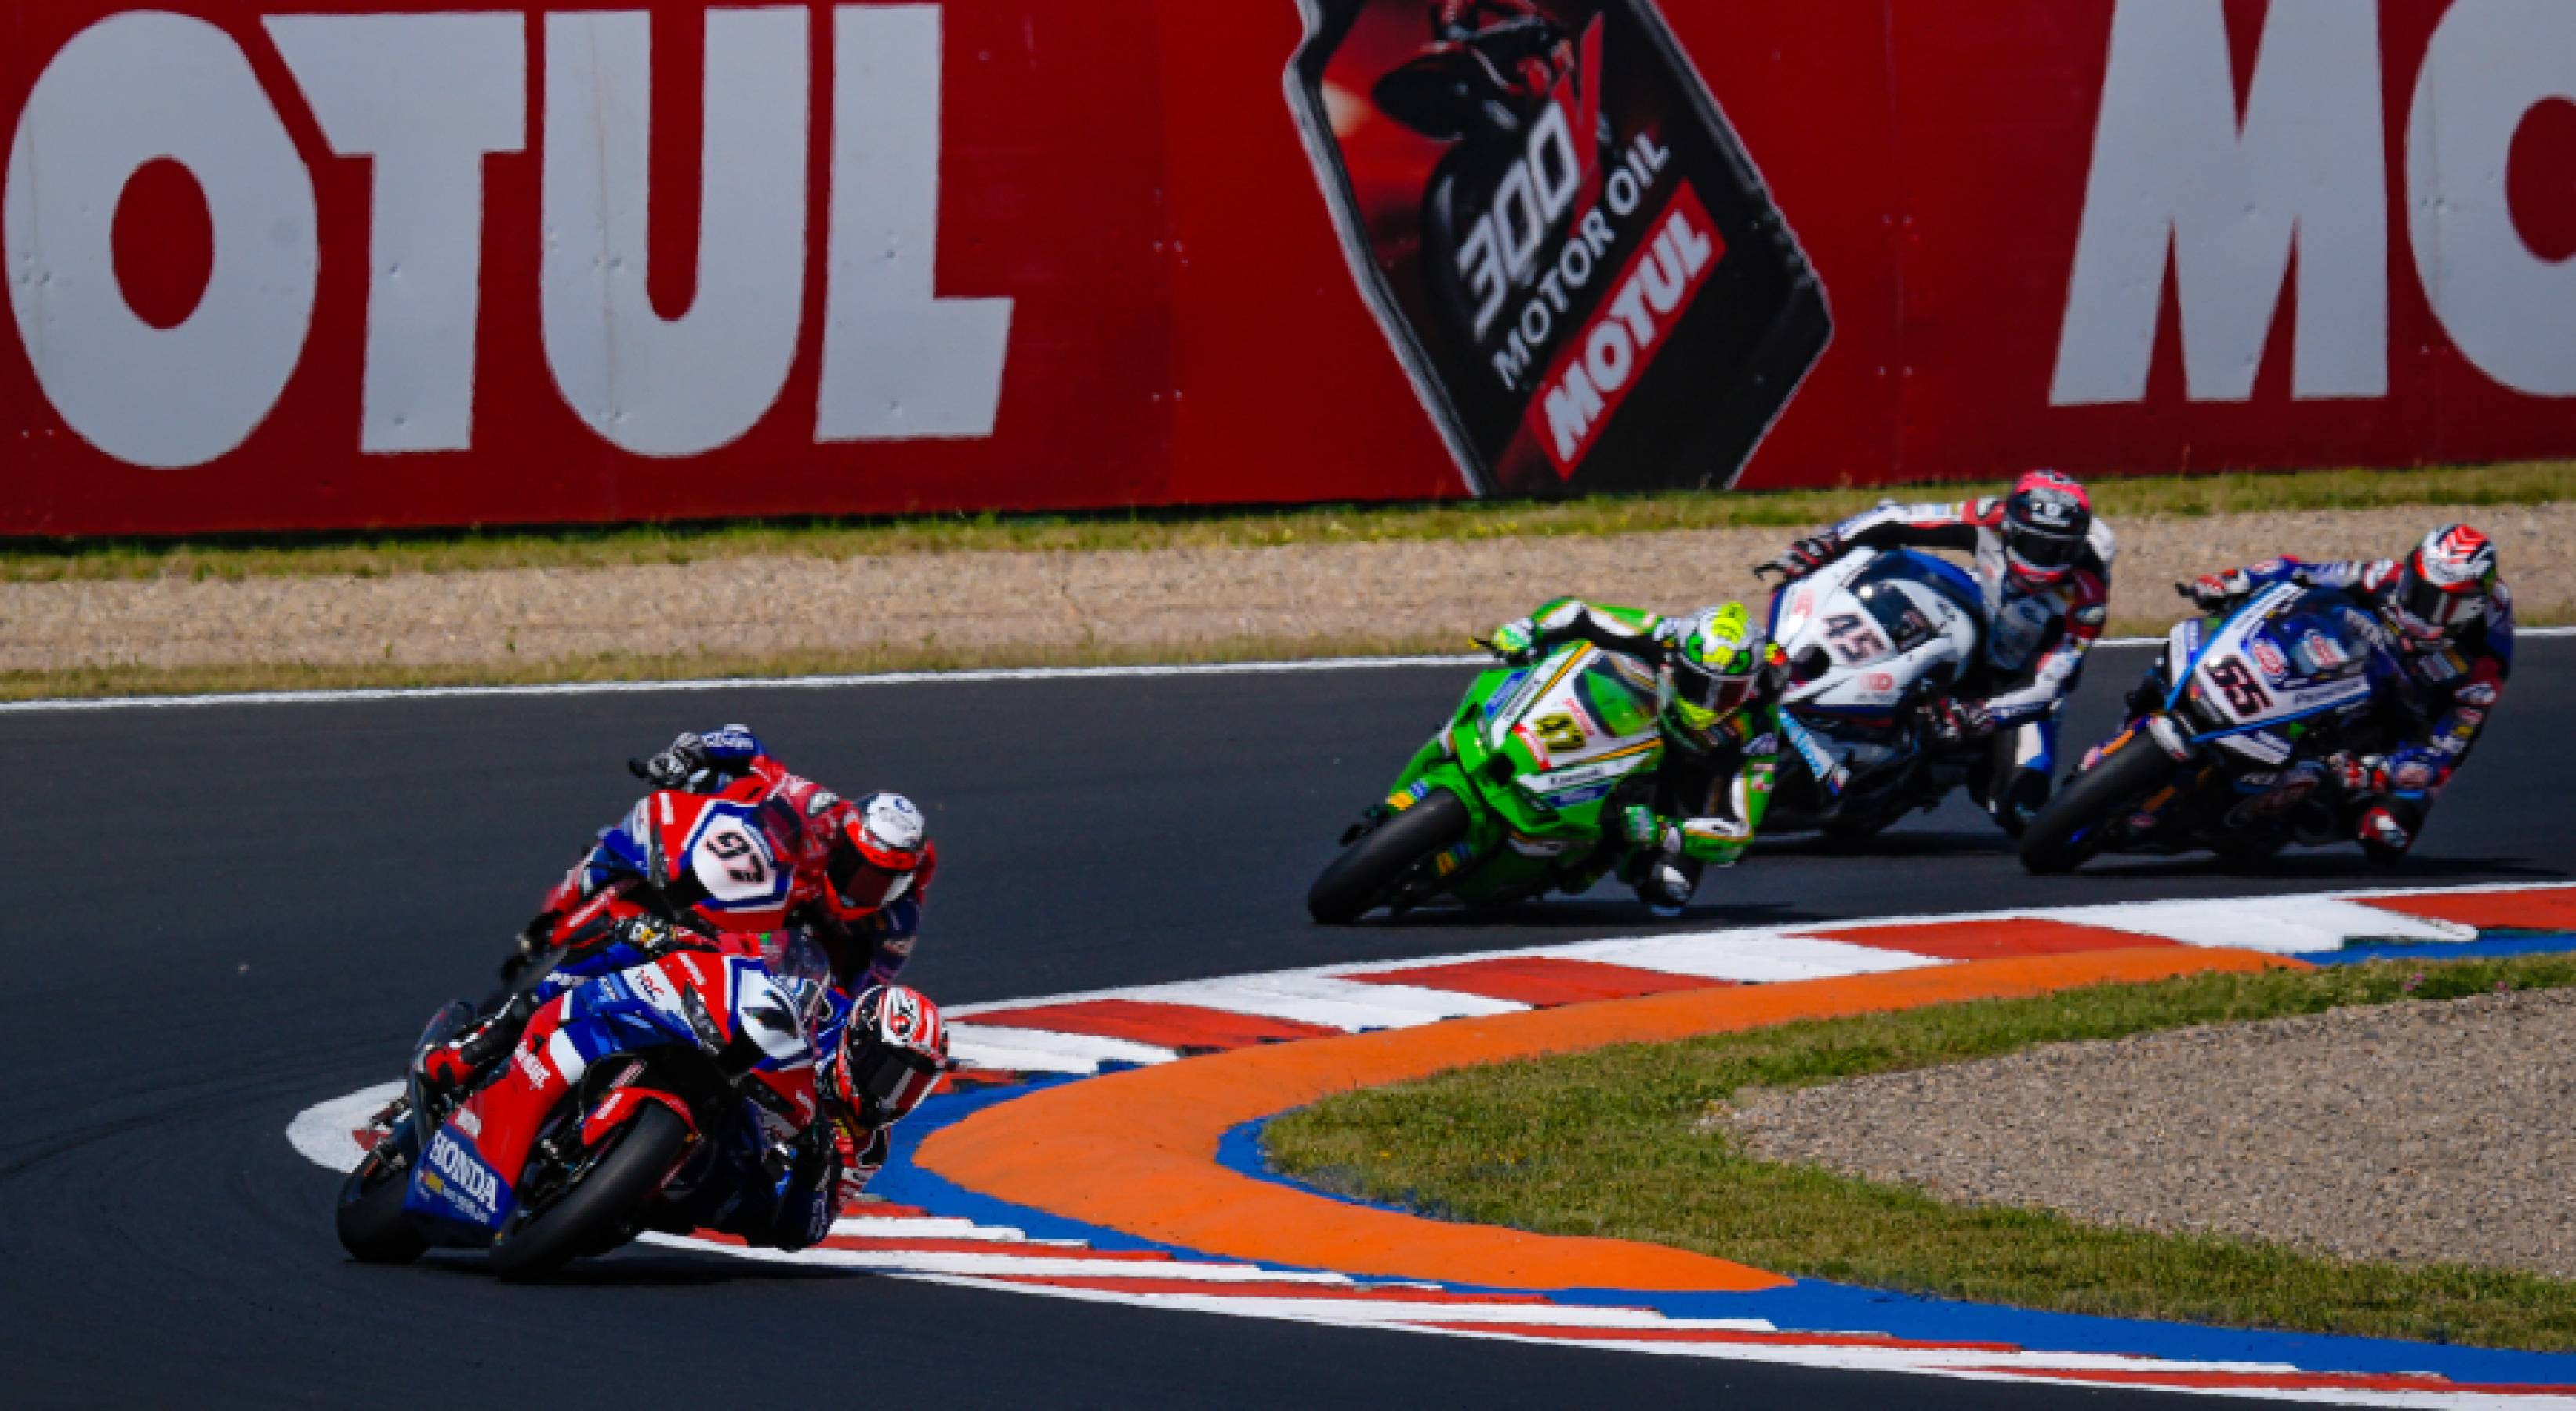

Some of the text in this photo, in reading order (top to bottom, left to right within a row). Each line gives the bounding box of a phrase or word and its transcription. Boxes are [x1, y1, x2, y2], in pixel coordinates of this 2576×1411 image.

[3, 4, 1014, 469] OTUL
[1492, 131, 1671, 390] MOTOR OIL
[1543, 209, 1713, 462] MOTUL
[1823, 611, 1887, 662] 45
[1535, 713, 1586, 753] 47
[705, 831, 767, 883] 97
[429, 1130, 499, 1213] HONDA
